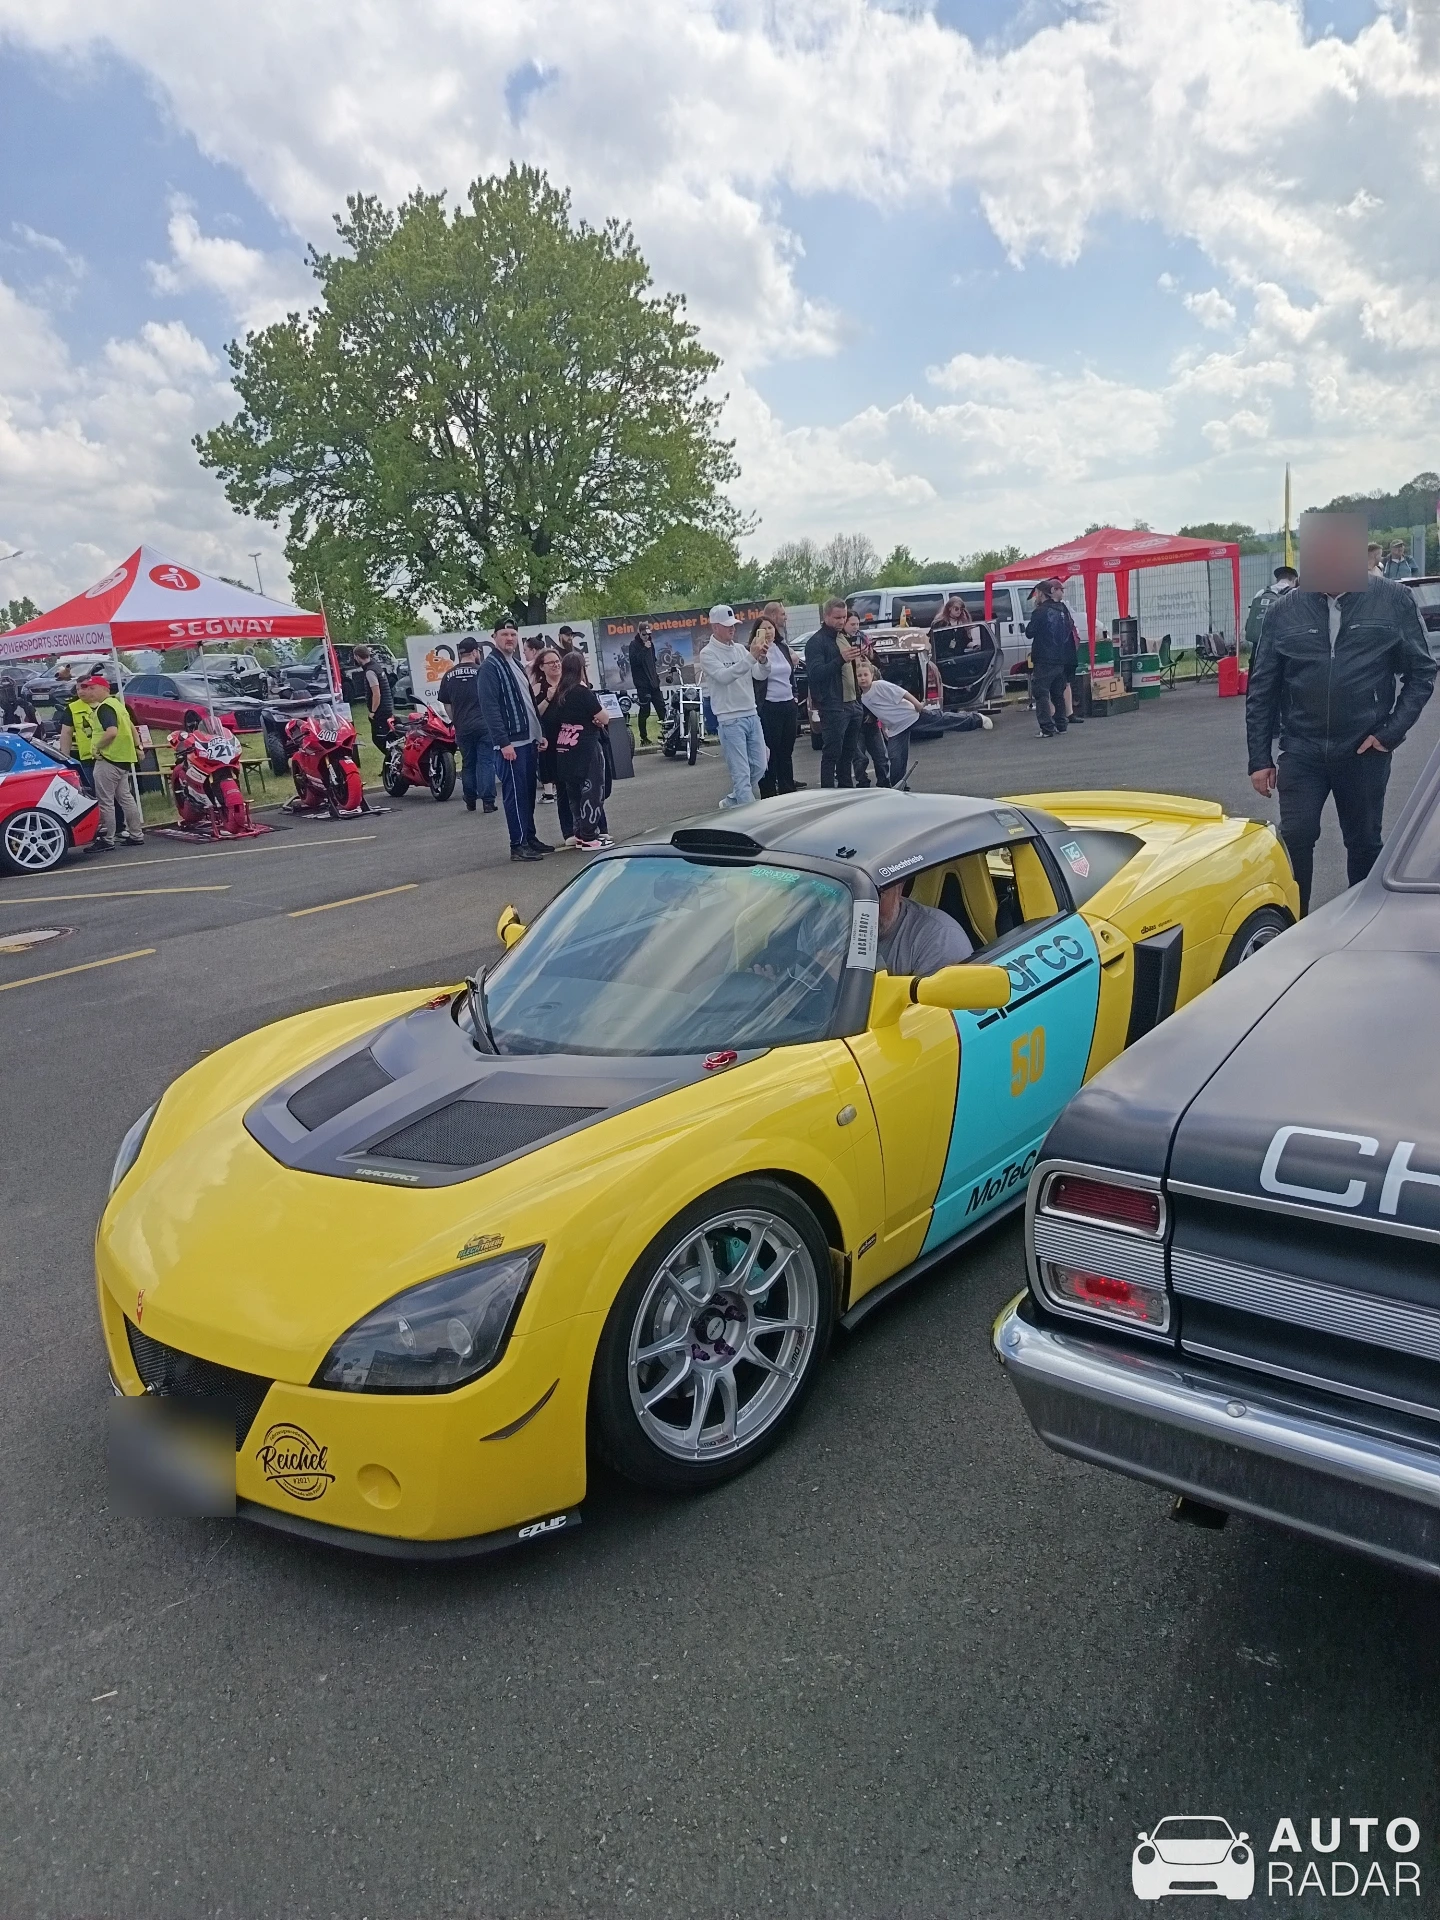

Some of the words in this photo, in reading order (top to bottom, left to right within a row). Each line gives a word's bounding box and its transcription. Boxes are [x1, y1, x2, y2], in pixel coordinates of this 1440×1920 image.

[168, 619, 275, 638] SEGWAY
[607, 623, 635, 636] Dein
[649, 617, 698, 632] benteuer
[887, 854, 924, 873] blechtriebe
[1010, 1025, 1046, 1098] 50
[964, 1149, 1037, 1217] MoTeC
[255, 1445, 328, 1474] Reichel
[293, 1477, 311, 1485] #2021
